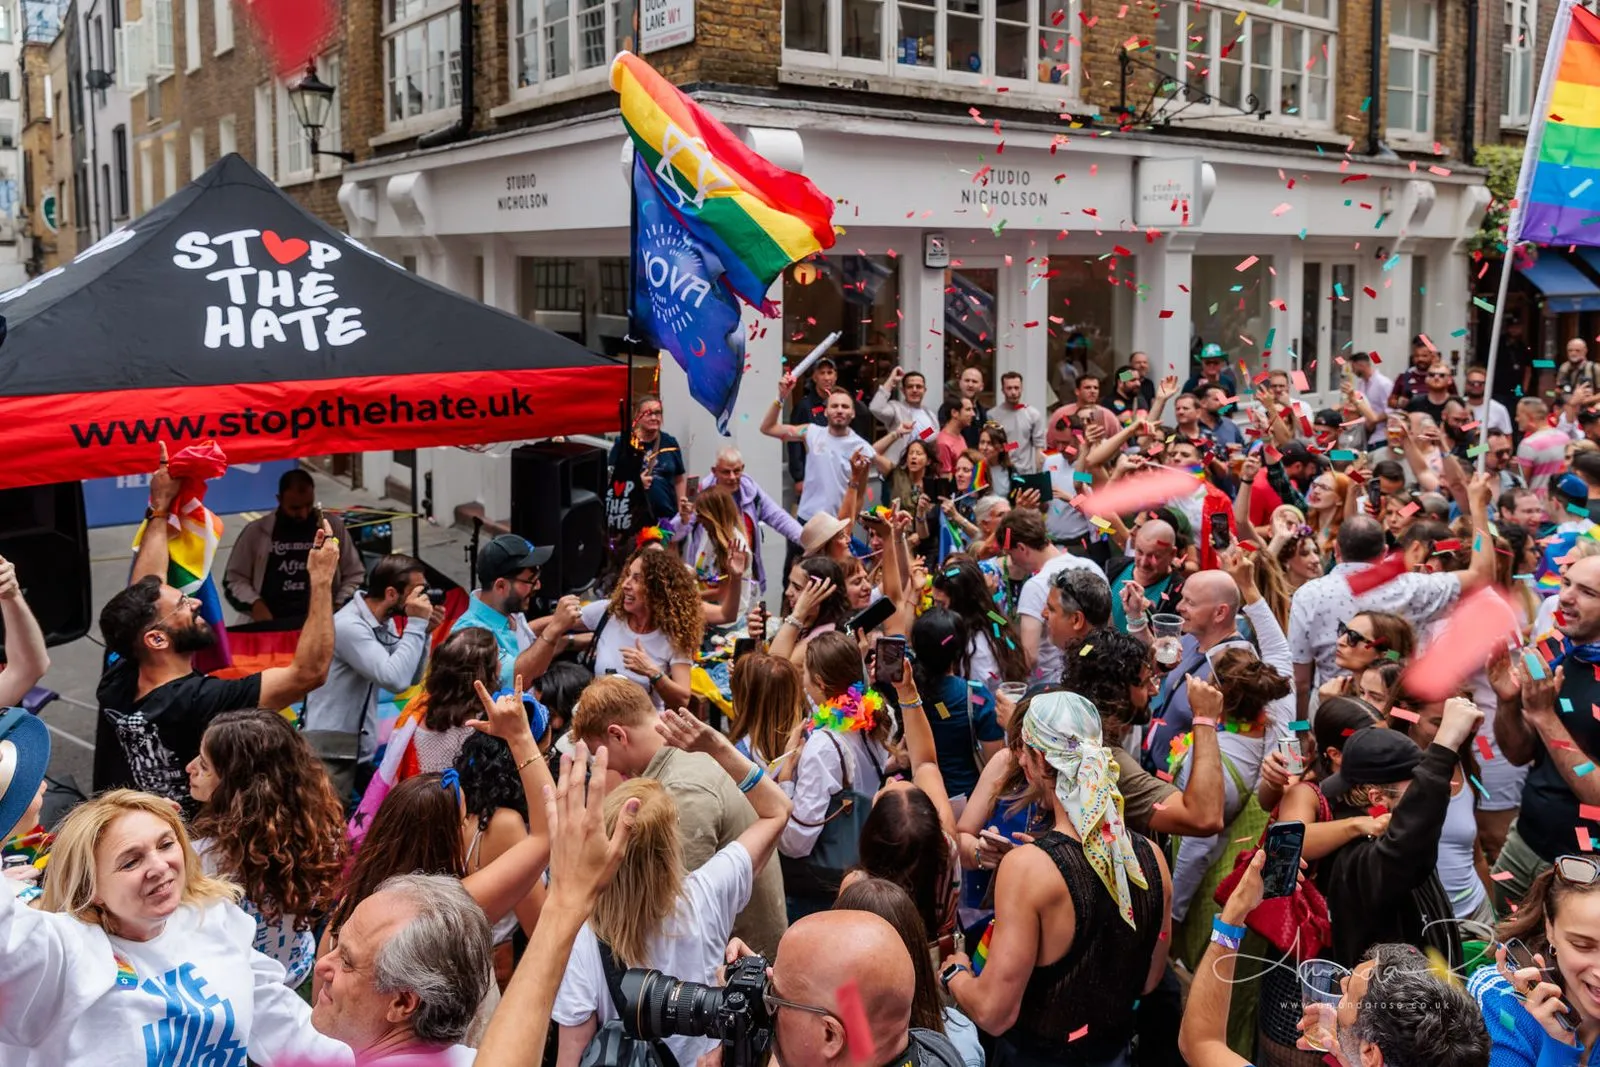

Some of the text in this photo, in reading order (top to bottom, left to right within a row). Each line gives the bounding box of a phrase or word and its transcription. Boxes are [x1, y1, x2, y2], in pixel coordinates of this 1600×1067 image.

[645, 8, 681, 31] LANE W1
[506, 173, 537, 190] STUDIO
[498, 193, 549, 210] NICHOLSON
[961, 189, 1048, 206] NICHOLSON
[205, 267, 339, 307] THE
[204, 306, 367, 351] HATE
[70, 388, 534, 448] www.stopthehate.uk
[141, 961, 220, 1018] WE
